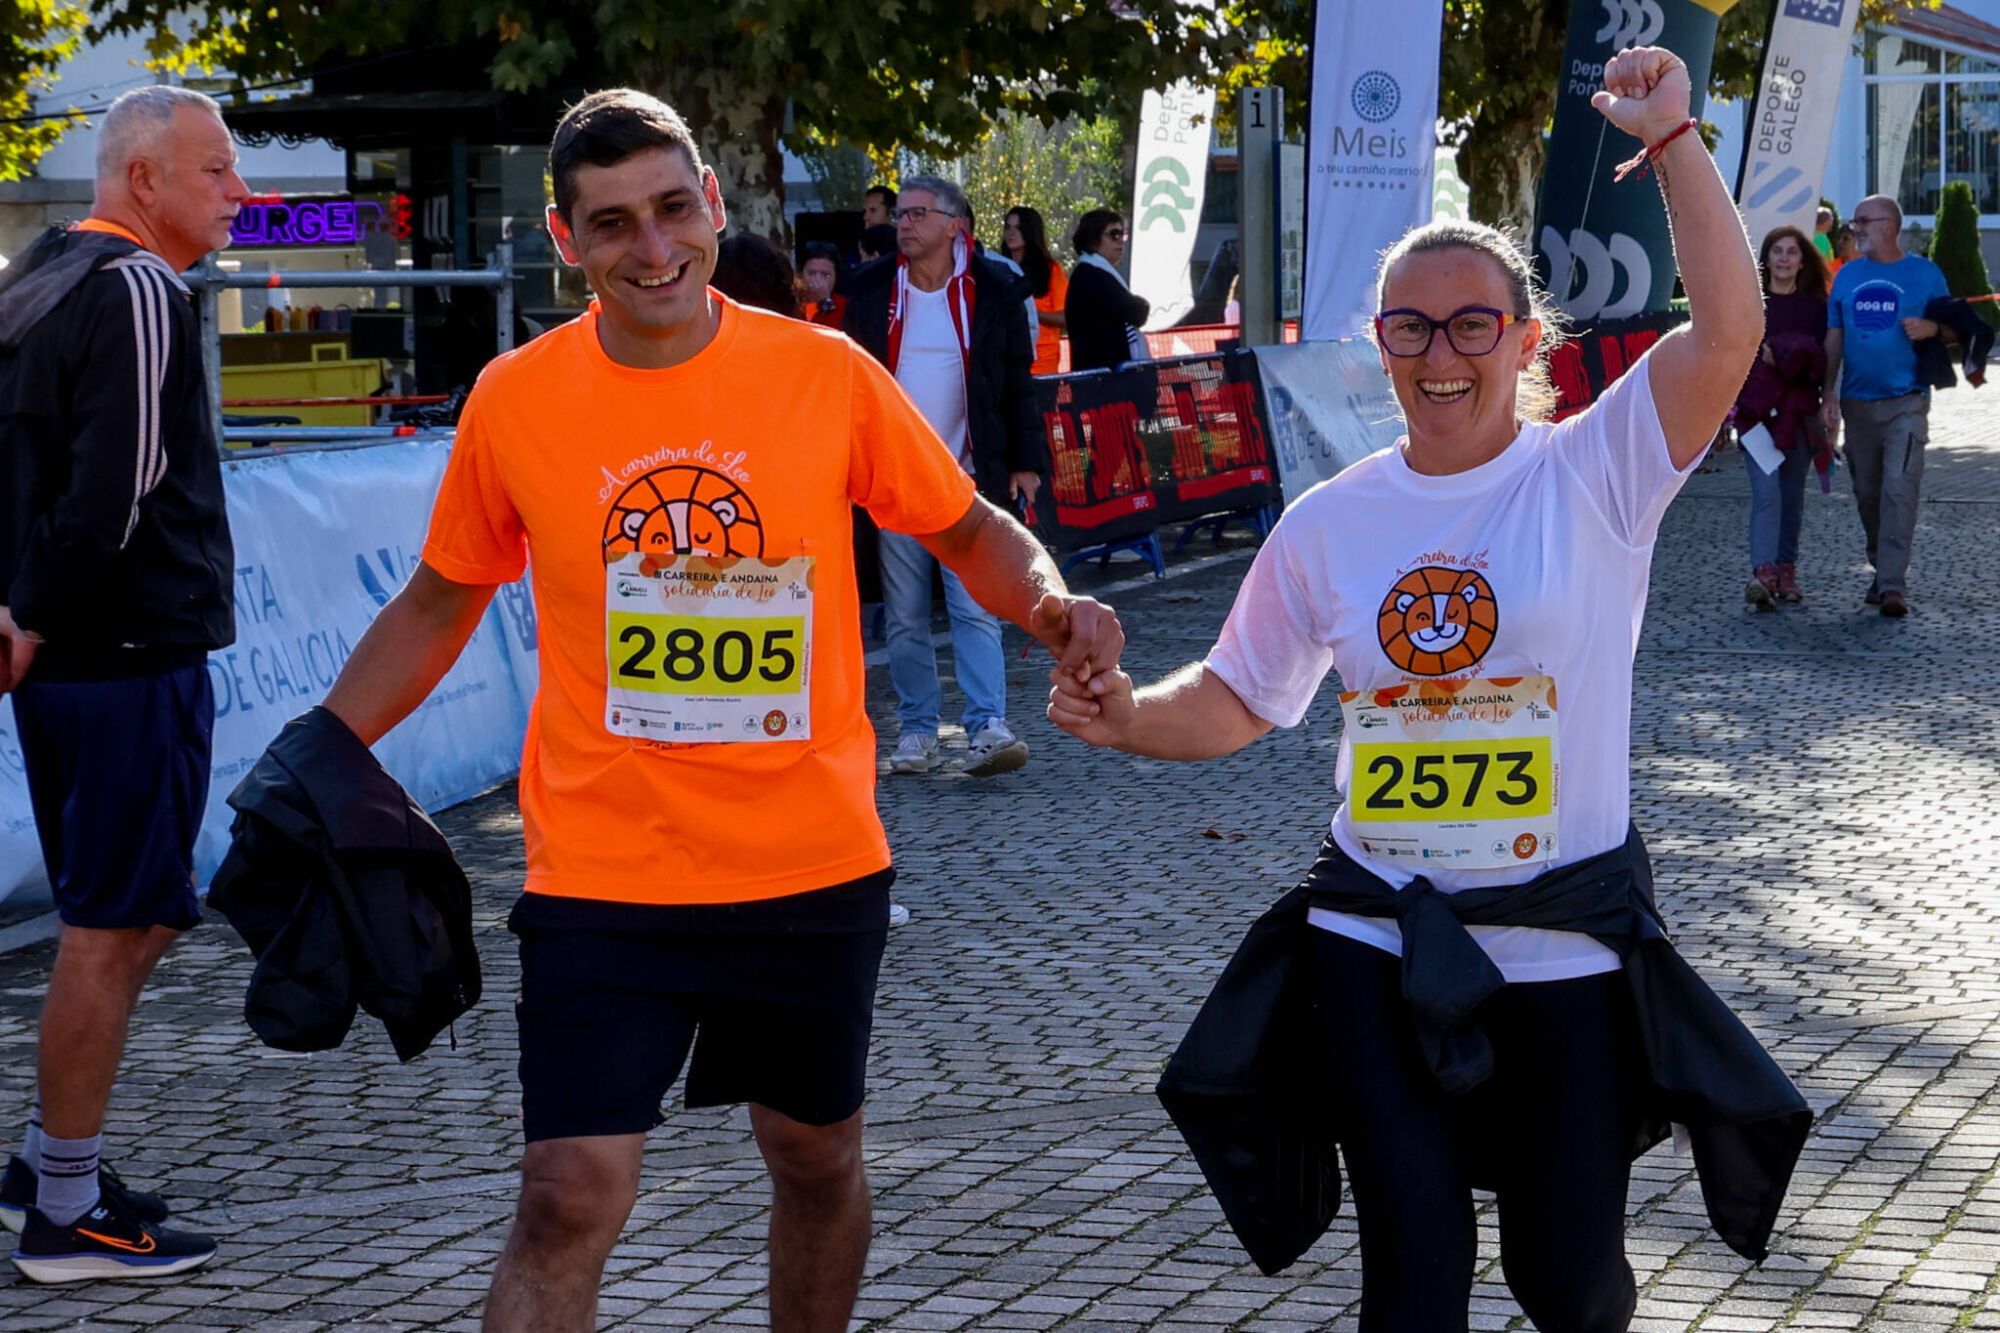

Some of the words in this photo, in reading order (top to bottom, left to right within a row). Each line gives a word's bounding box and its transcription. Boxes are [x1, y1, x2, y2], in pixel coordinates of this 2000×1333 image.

[1569, 79, 1604, 96] Pon
[1572, 59, 1602, 81] Dep
[1154, 94, 1178, 142] Dep
[1250, 91, 1265, 128] i
[1758, 55, 1790, 153] DEPORTE
[1777, 69, 1806, 155] GALEGO
[1333, 126, 1407, 158] Meis
[1346, 164, 1386, 175] camiño
[230, 201, 385, 244] URGER
[620, 446, 692, 478] carreira
[692, 439, 717, 464] de
[716, 450, 752, 484] Leo
[664, 570, 718, 583] CARREIRA
[721, 574, 727, 583] E
[730, 574, 779, 584] ANDAINA
[664, 581, 731, 600] solidaria
[736, 583, 752, 599] de
[758, 581, 776, 602] Leo
[250, 626, 351, 706] GALICIA
[619, 625, 795, 684] 2805
[1400, 697, 1451, 709] CARREIRA
[1454, 696, 1460, 706] E
[1462, 694, 1514, 707] ANDAINA
[1402, 706, 1464, 726] solidaria
[1468, 704, 1487, 721] de
[1492, 703, 1514, 723] Leo
[1366, 751, 1538, 809] 2573
